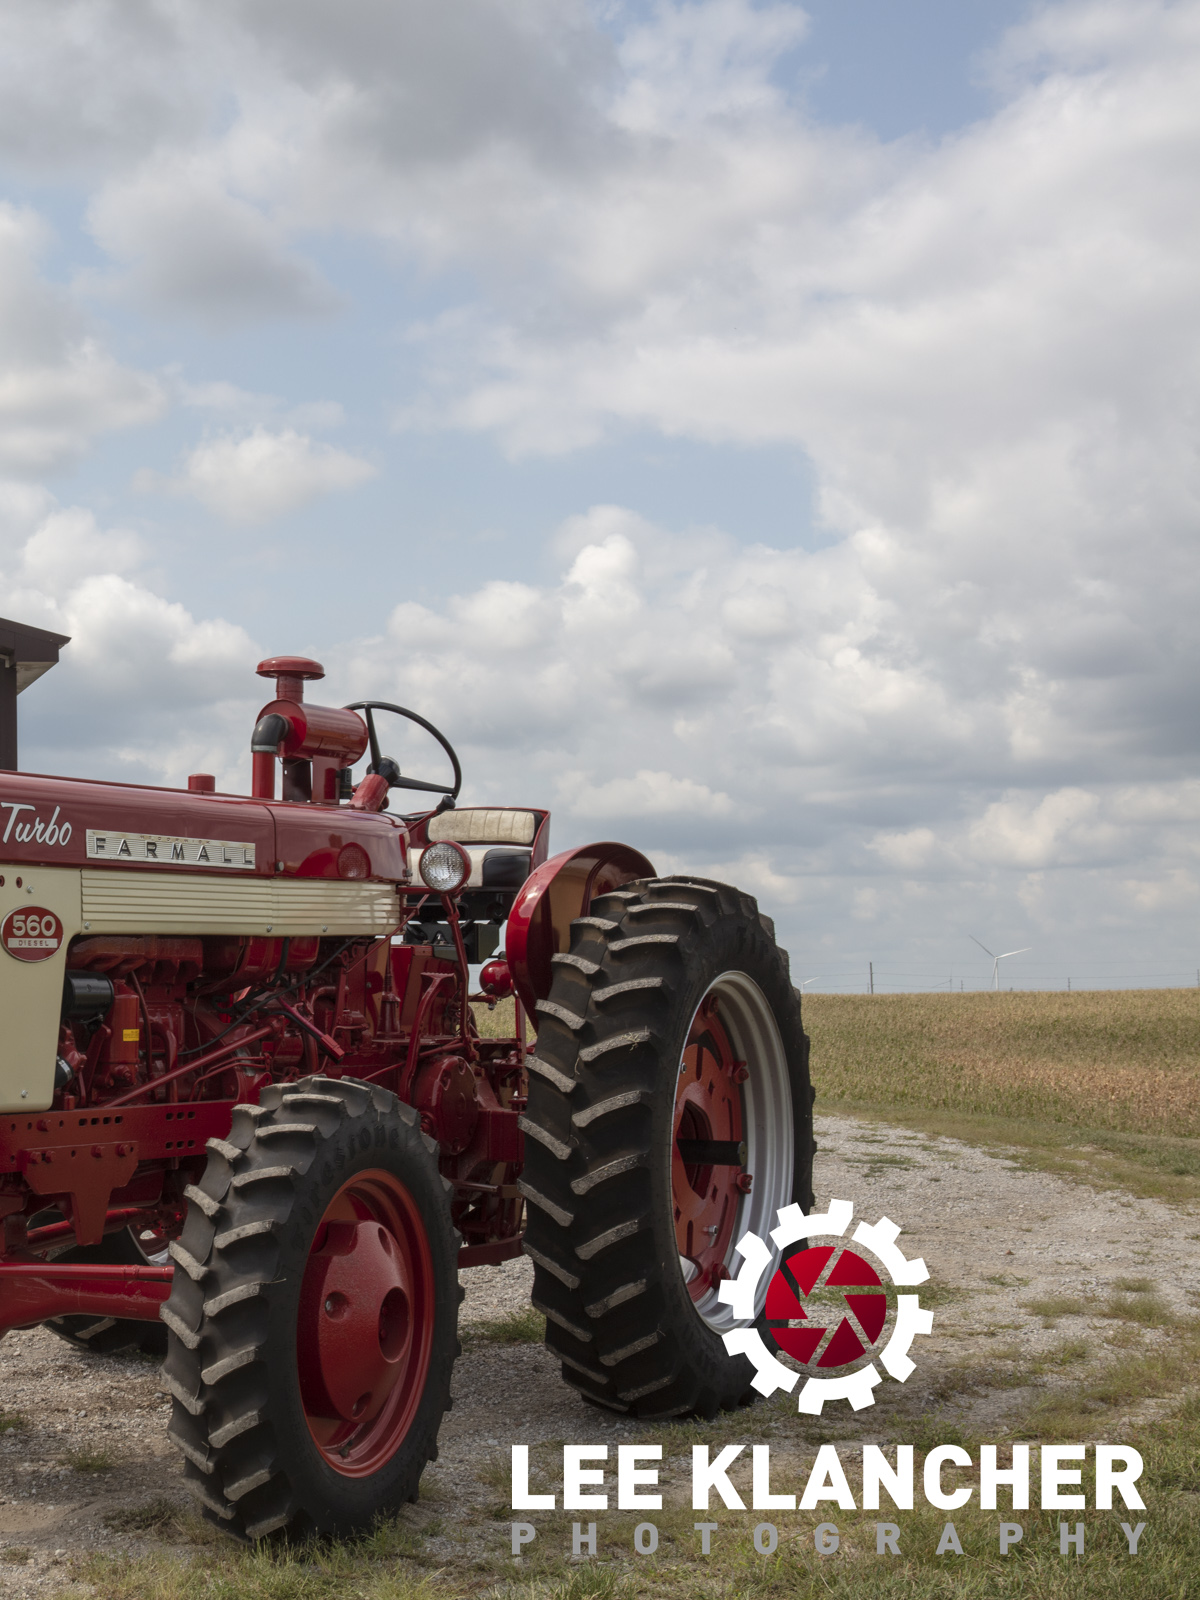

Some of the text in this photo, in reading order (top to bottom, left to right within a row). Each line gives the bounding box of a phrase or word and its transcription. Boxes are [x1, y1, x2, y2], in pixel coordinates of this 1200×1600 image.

[0, 801, 72, 847] Turbo
[93, 837, 254, 865] FARMALL
[12, 914, 56, 937] 560
[18, 939, 50, 947] DIESEL
